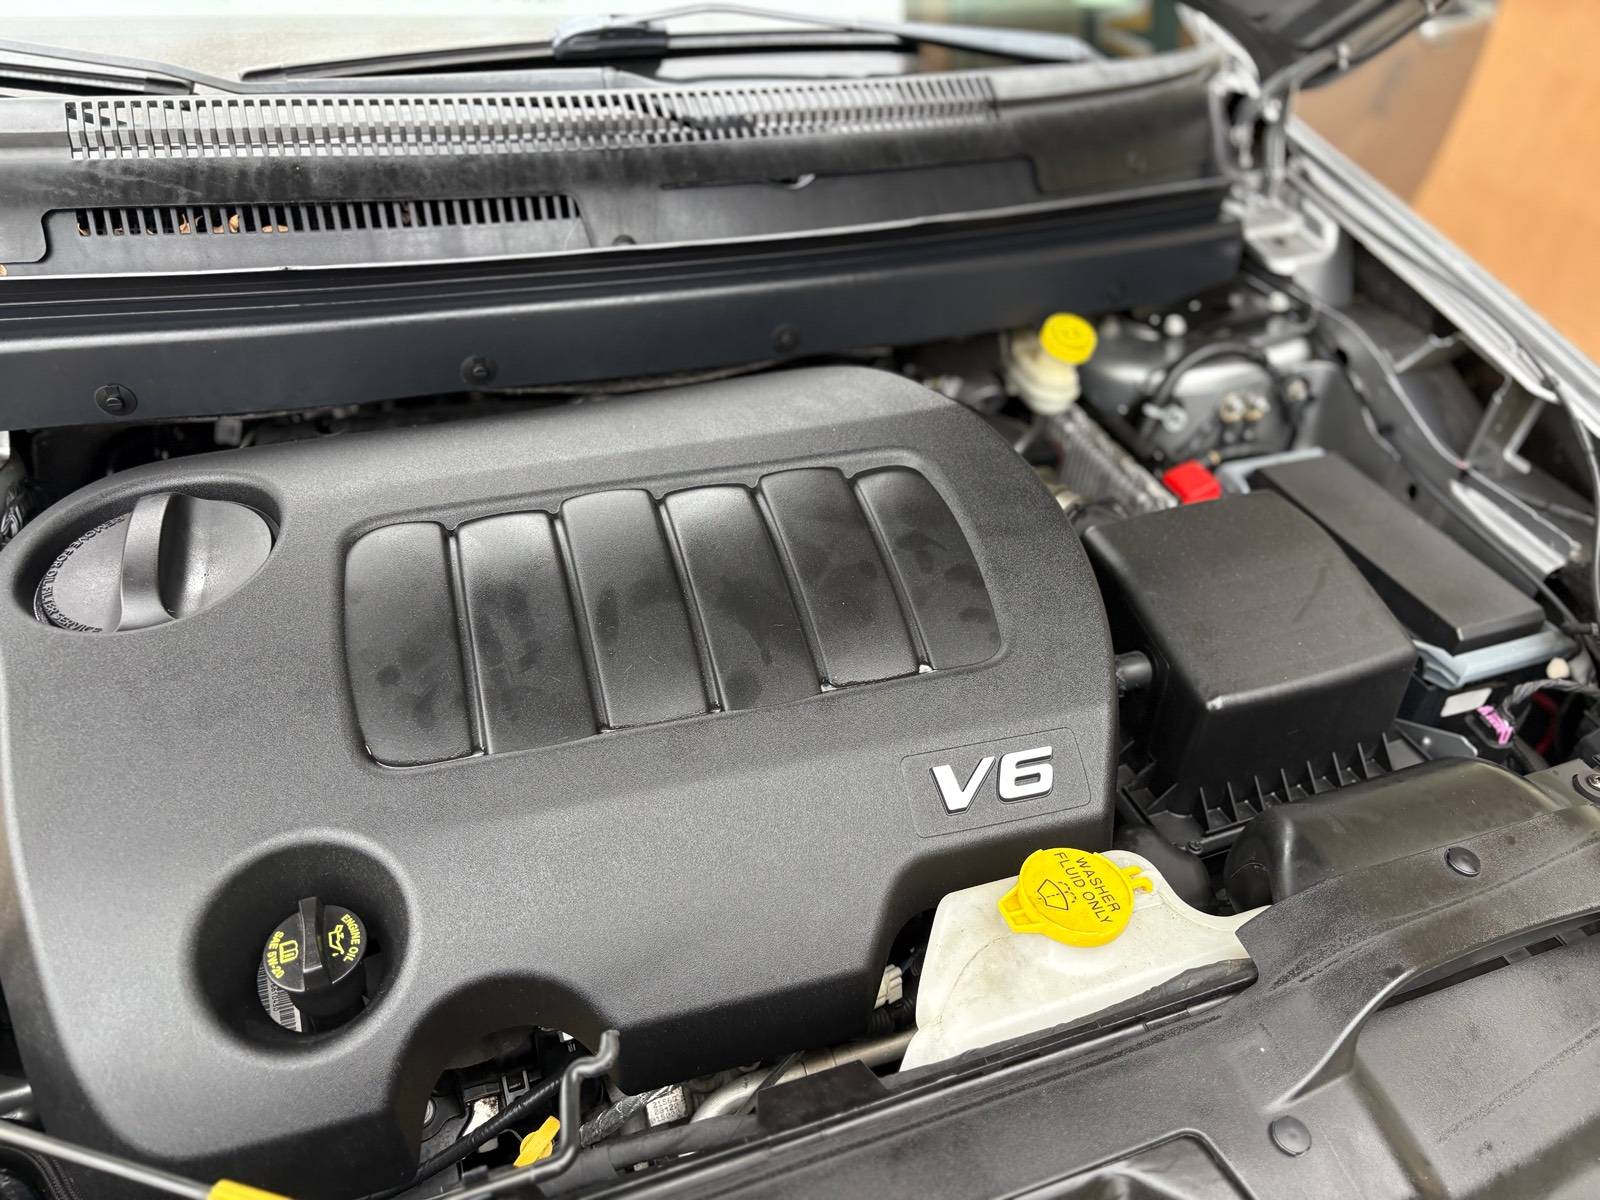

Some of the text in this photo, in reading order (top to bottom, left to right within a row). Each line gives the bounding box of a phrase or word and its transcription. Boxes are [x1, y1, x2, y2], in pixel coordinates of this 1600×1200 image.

[41, 516, 124, 633] REMOVE FOR OIL FILTER SERVICE
[929, 746, 1053, 815] V6
[1054, 852, 1113, 923] FLUID ONLY
[1076, 857, 1121, 912] WASHER
[267, 931, 285, 978] SAE 5W-20
[341, 914, 360, 962] ENGINE OIL
